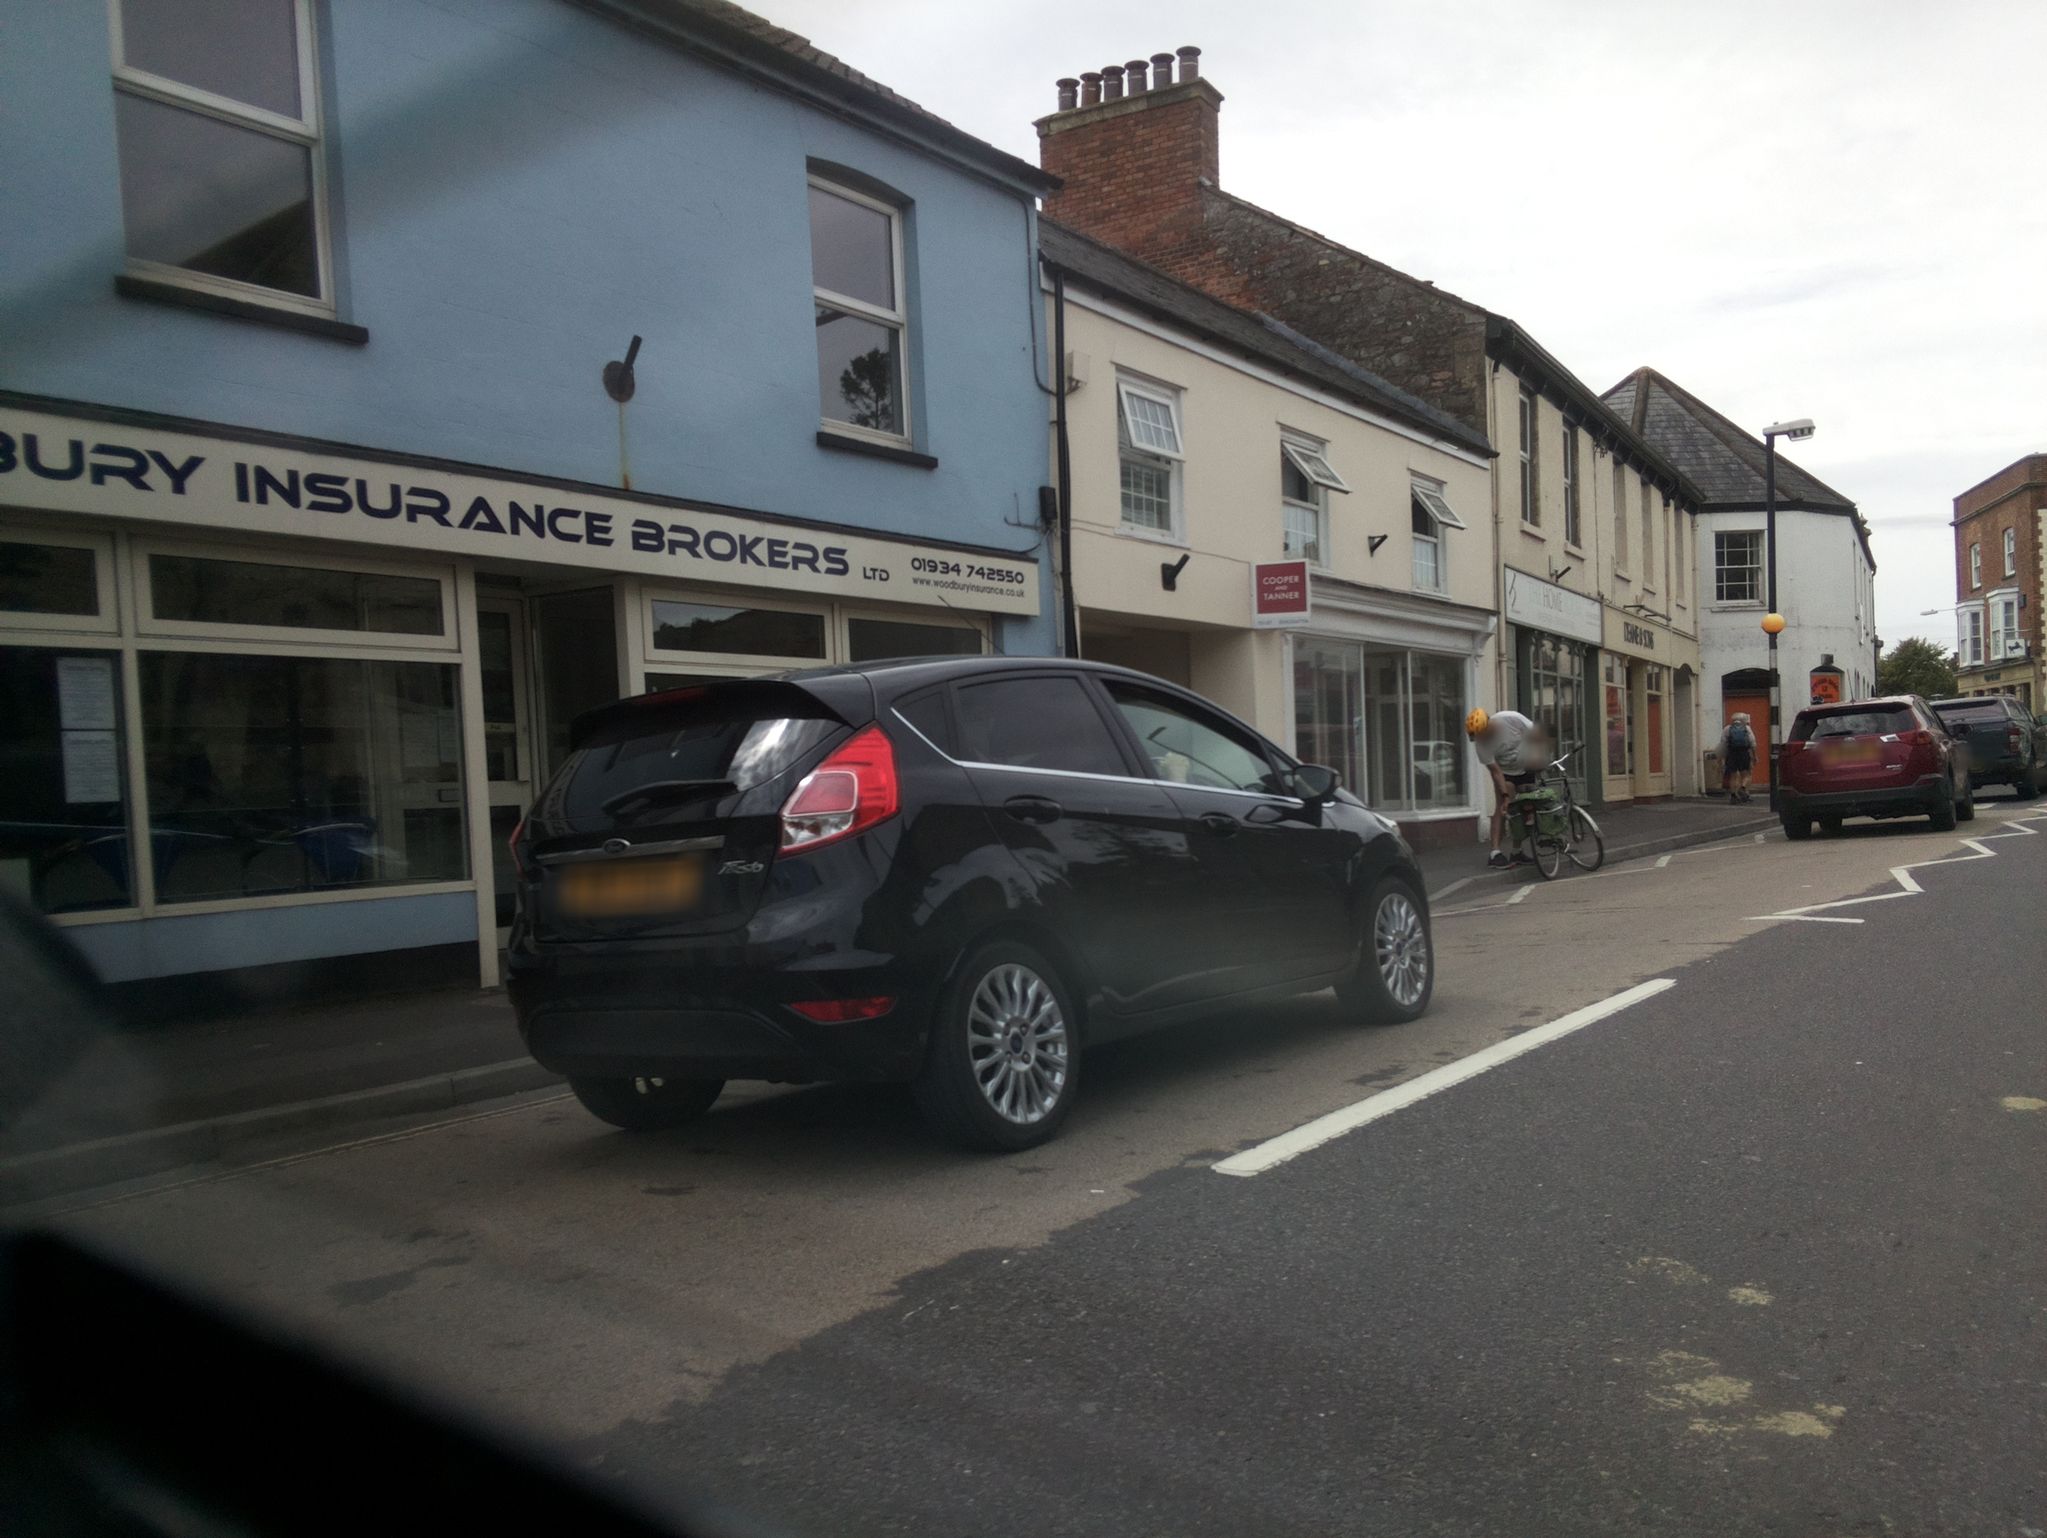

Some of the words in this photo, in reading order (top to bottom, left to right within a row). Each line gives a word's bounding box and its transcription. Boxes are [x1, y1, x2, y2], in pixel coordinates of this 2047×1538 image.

[235, 462, 614, 548] INSURANCE
[631, 518, 850, 576] BROKERS
[862, 566, 890, 582] LTD
[911, 557, 961, 576] 01934
[967, 564, 1025, 584] 742550
[1263, 575, 1300, 585] COOPER
[912, 577, 1025, 598] www.woodburyinsurance.co.uk
[1263, 591, 1300, 601] TANNER
